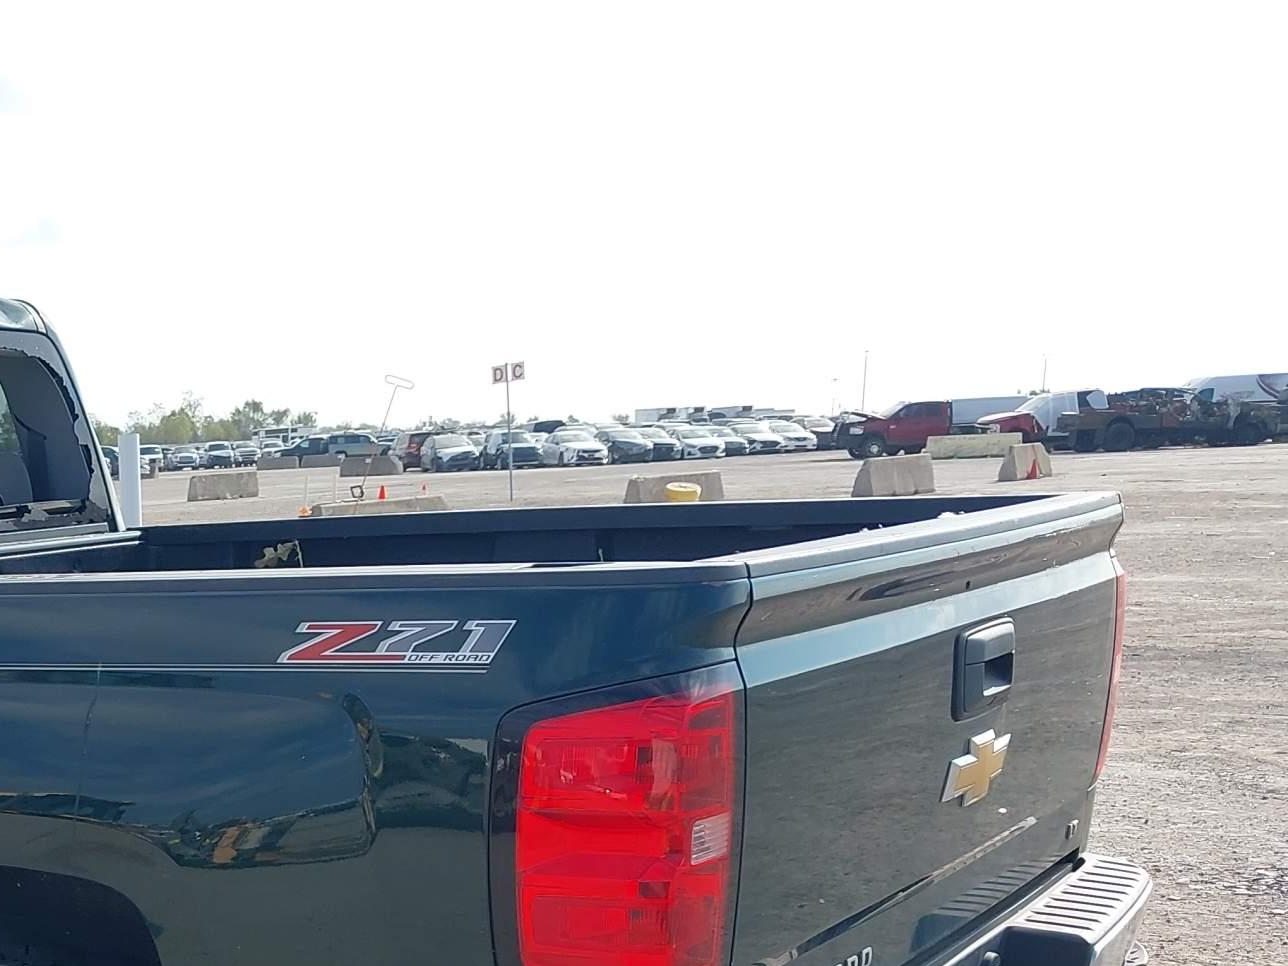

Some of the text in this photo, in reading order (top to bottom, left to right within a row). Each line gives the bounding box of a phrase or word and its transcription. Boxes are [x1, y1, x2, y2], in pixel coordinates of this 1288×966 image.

[492, 367, 504, 382] D
[512, 363, 523, 379] C
[276, 619, 517, 664] Z71
[407, 653, 491, 662] OFF ROAD
